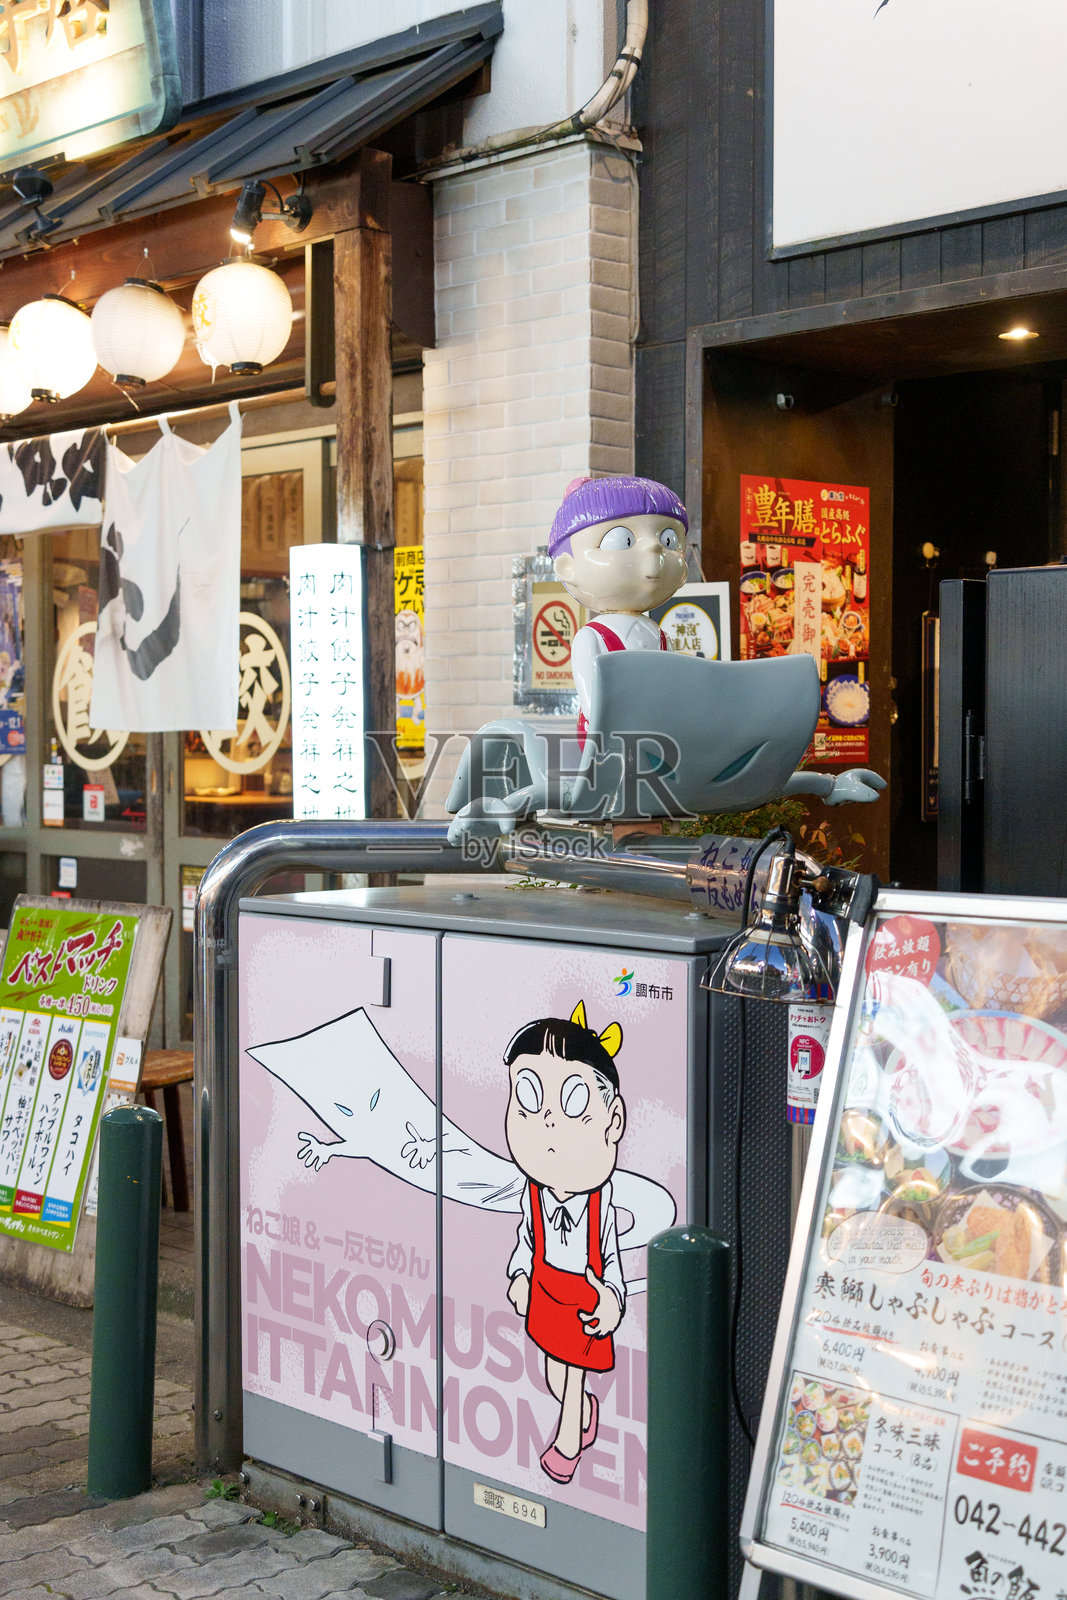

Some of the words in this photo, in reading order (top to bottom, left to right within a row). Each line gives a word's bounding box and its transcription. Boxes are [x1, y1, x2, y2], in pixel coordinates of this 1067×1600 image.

[820, 520, 867, 546] とらふぐ
[535, 671, 545, 680] NO
[873, 958, 932, 978] ラン有り
[83, 975, 117, 994] ドリンク
[636, 982, 674, 1001] 調布市
[28, 1103, 50, 1170] ハイボール
[34, 1092, 62, 1186] アップルワイン
[63, 1114, 84, 1177] タコハイ
[823, 1338, 866, 1362] 6,400円
[873, 1443, 903, 1460] コース
[963, 1442, 1031, 1482] ご予約
[512, 1501, 537, 1521] 694
[791, 1516, 830, 1542] 5,400円
[955, 1494, 1067, 1556] 042-442
[869, 1543, 911, 1569] 3,900円
